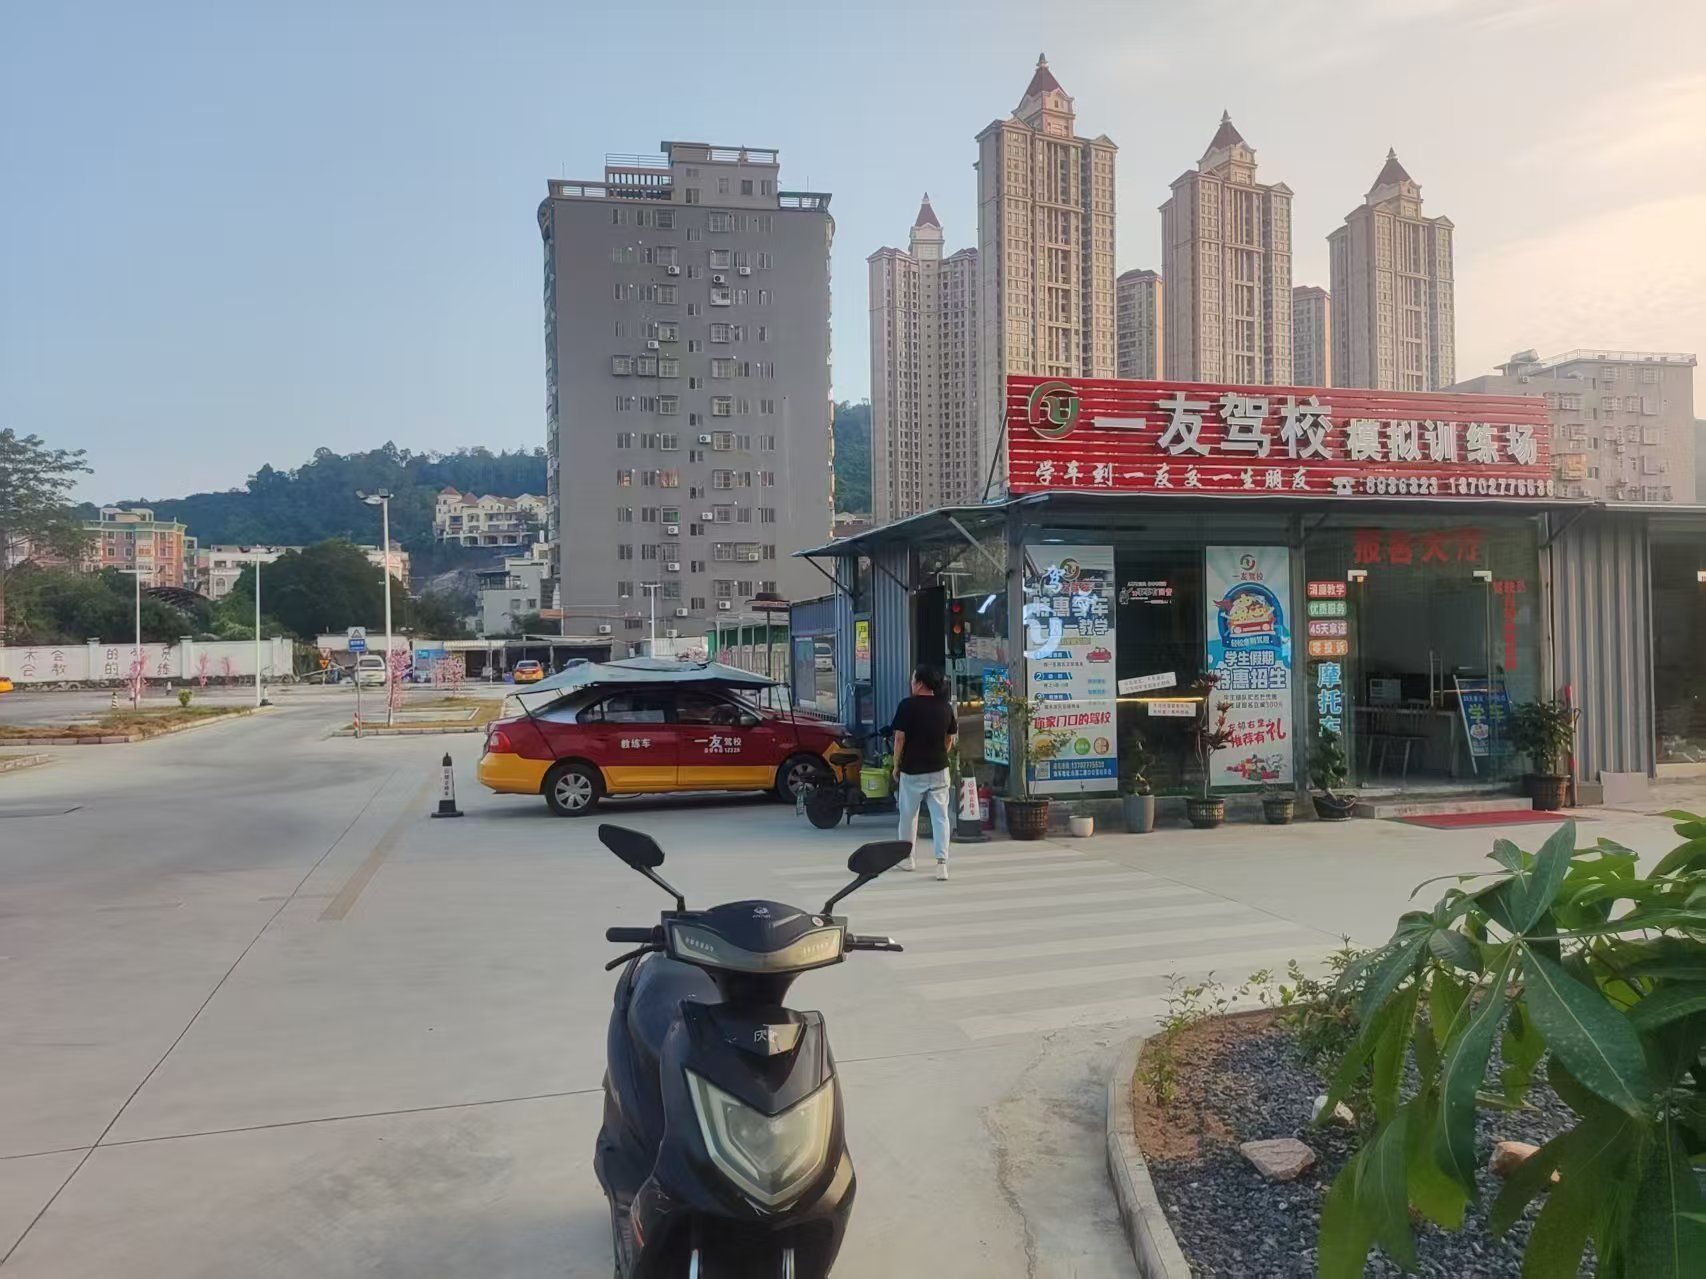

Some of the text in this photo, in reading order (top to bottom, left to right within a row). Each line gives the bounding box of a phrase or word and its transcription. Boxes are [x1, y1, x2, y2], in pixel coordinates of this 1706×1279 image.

[1093, 391, 1538, 465] 一友驾校 模拟训练场
[1309, 603, 1346, 615] 优质服务
[1034, 617, 1109, 636] 一一教学
[1225, 650, 1275, 667] 学生假期
[1214, 668, 1287, 690] 特惠招生
[1317, 662, 1342, 737] 摩托车
[1034, 712, 1112, 730] 你家门口的驾校
[621, 738, 652, 749] 教练车
[694, 734, 742, 748] 一友驾校
